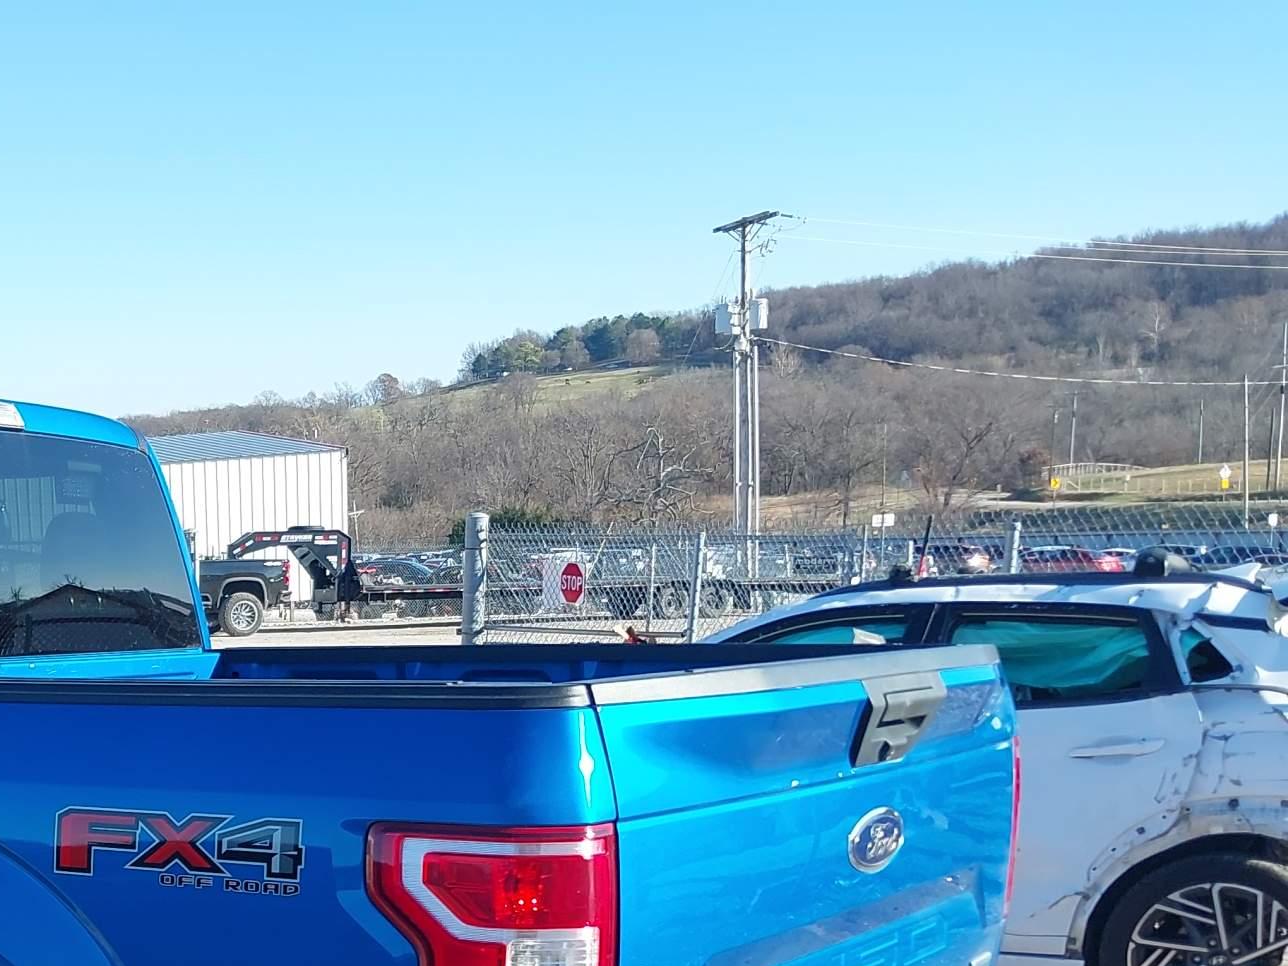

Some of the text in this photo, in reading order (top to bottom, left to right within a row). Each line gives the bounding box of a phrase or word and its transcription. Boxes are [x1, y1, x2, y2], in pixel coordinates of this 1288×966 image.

[561, 575, 583, 591] STOP
[54, 806, 305, 882] FX4
[159, 873, 301, 897] OFF ROAD
